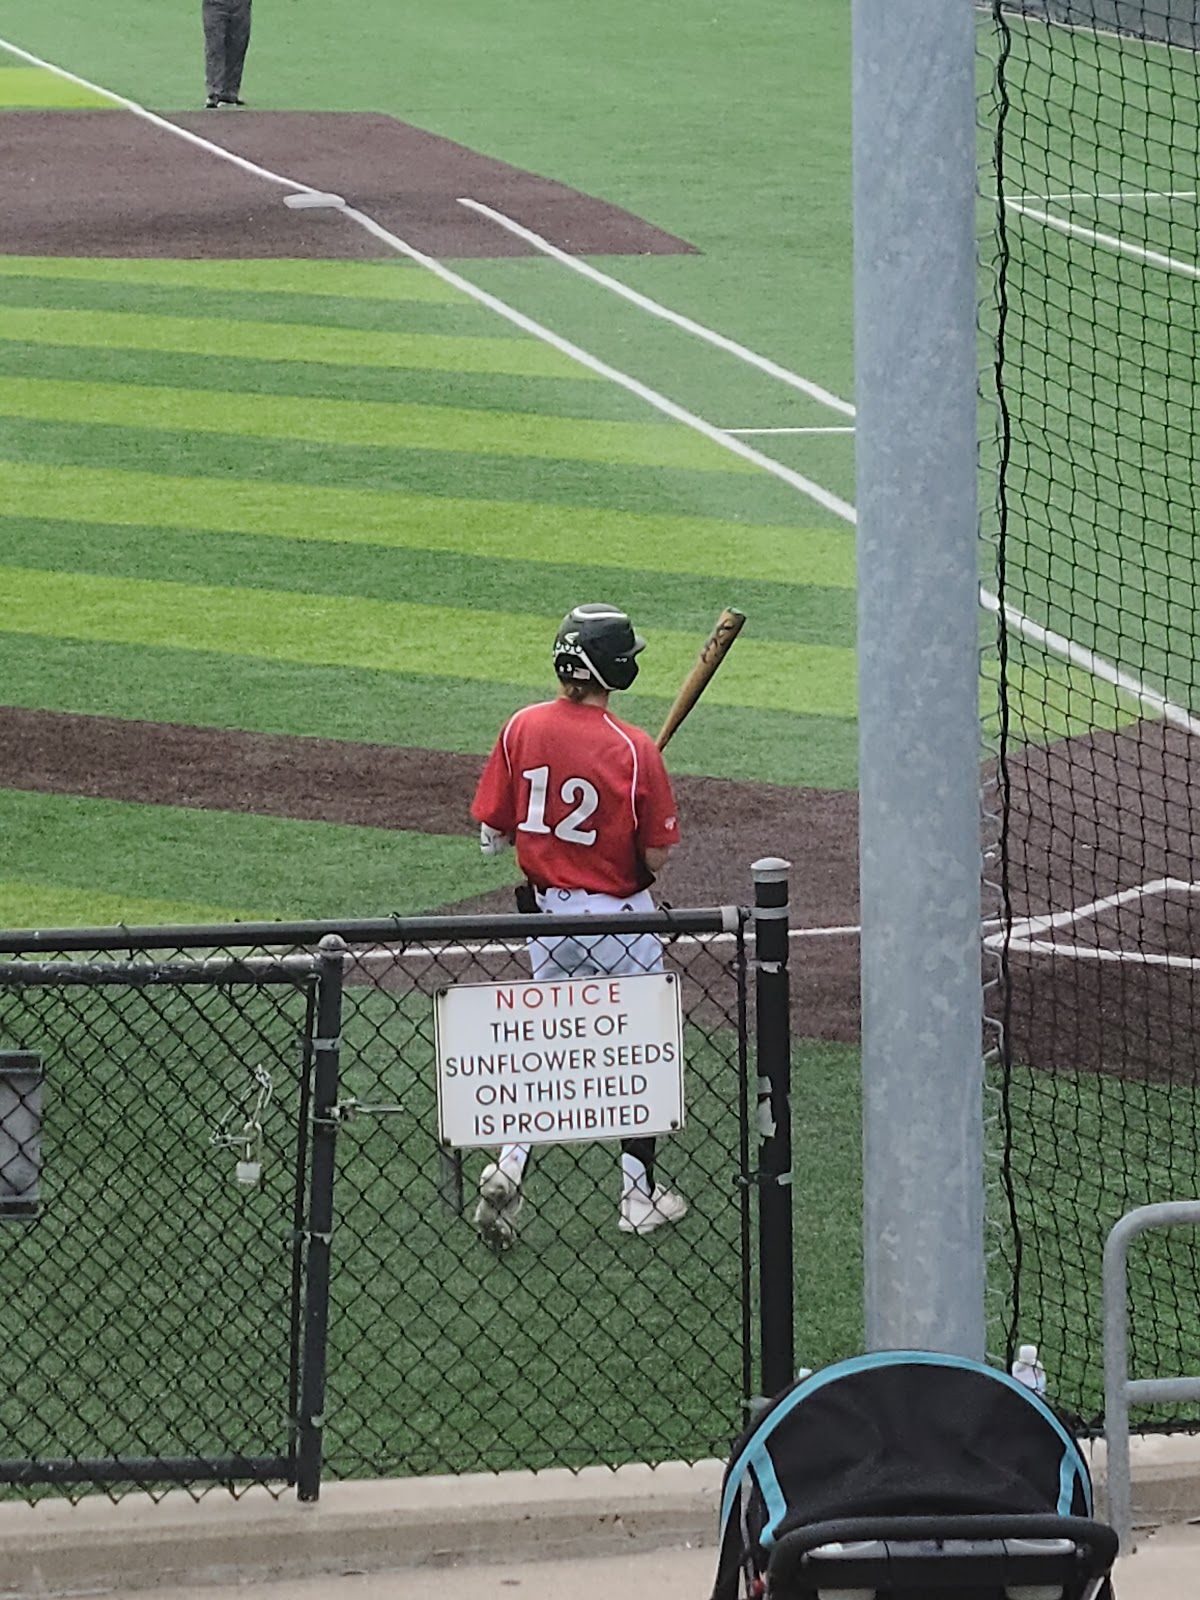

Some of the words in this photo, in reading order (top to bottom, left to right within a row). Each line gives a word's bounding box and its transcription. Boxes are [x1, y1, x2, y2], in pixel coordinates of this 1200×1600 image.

[517, 765, 599, 847] 12
[496, 983, 621, 1009] NOTICE
[490, 1020, 535, 1042] THE
[542, 1017, 587, 1039] USE
[594, 1013, 628, 1036] OF
[445, 1049, 597, 1077] SUNFLOWER
[602, 1042, 675, 1067] SEEDS
[475, 1084, 517, 1105] ON
[524, 1079, 577, 1102] THIS
[583, 1074, 648, 1099] FIELD
[474, 1114, 495, 1136] IS
[502, 1104, 650, 1134] PROHIBITED
